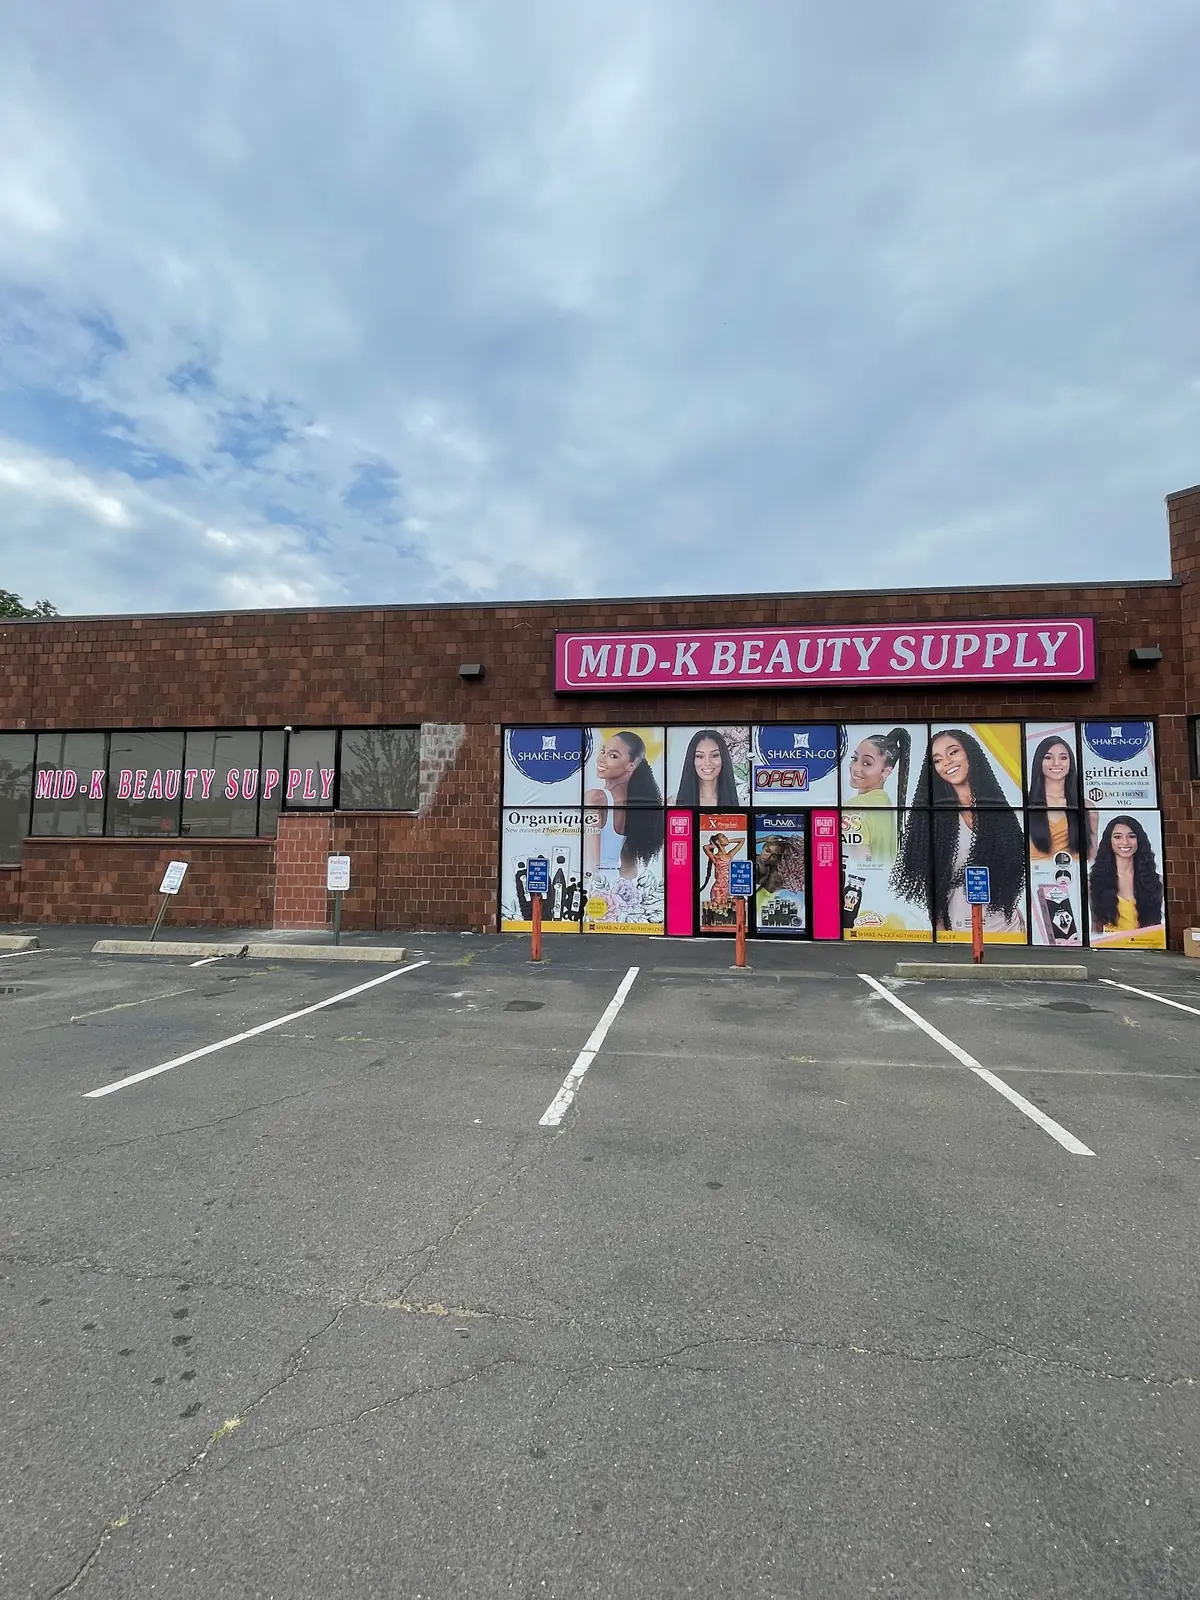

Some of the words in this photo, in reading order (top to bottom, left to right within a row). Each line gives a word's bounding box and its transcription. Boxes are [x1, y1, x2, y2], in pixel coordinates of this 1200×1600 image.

[578, 642, 700, 677] MID-K
[709, 636, 881, 675] BEAUTY
[889, 631, 1068, 671] SUPPLY
[518, 751, 580, 761] SHAKE-N-GO
[767, 749, 836, 759] SHAKE-N-GO
[756, 769, 807, 788] OPEN
[1085, 766, 1148, 781] girlfriend
[35, 769, 105, 799] MID-K
[117, 769, 215, 800] BEAUTY
[1090, 789, 1102, 800] HD
[509, 811, 594, 827] Organique
[763, 819, 795, 827] RUWA
